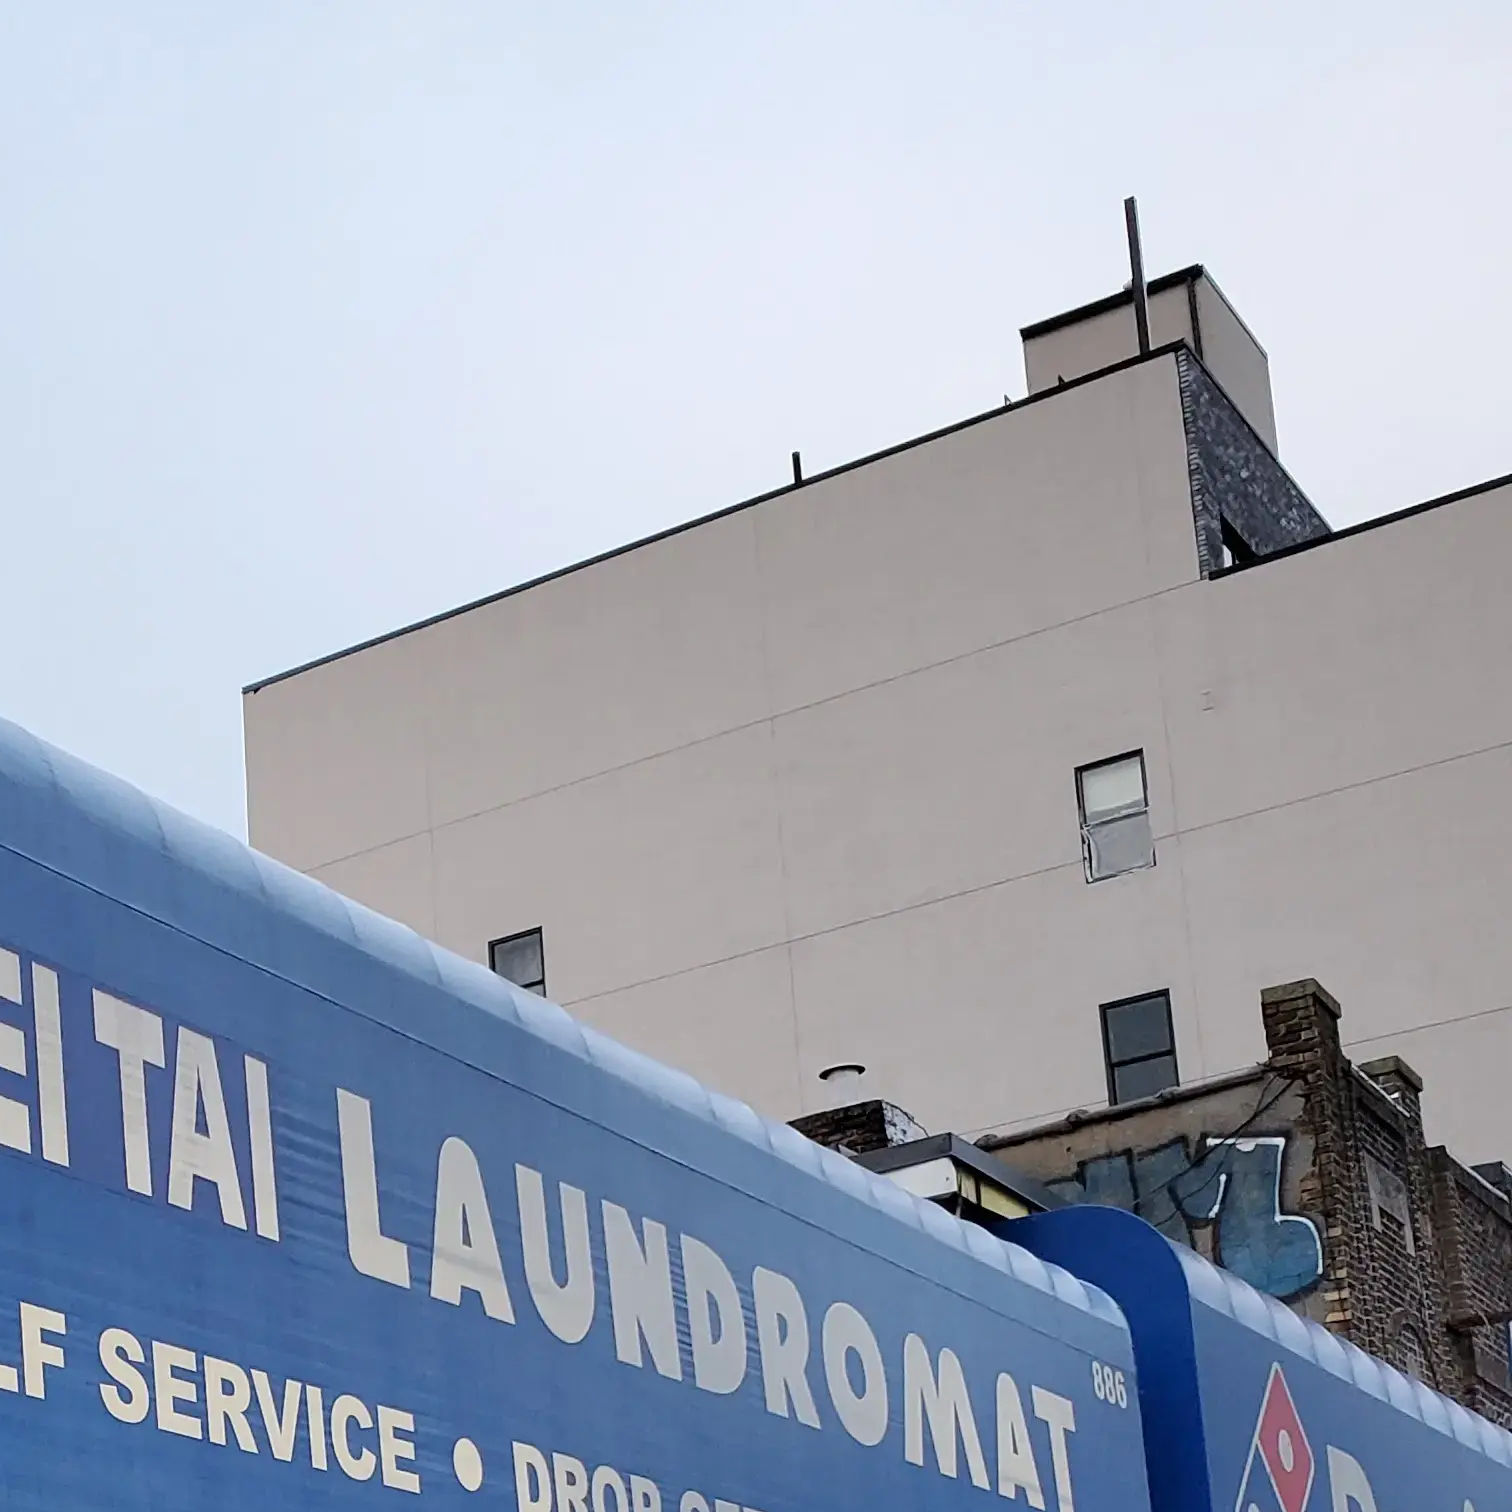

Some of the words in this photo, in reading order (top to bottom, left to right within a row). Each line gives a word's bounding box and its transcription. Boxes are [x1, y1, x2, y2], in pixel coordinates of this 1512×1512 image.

[92, 988, 279, 1242] TAI
[99, 1327, 422, 1494] SERVICE
[1092, 1361, 1128, 1409] 886
